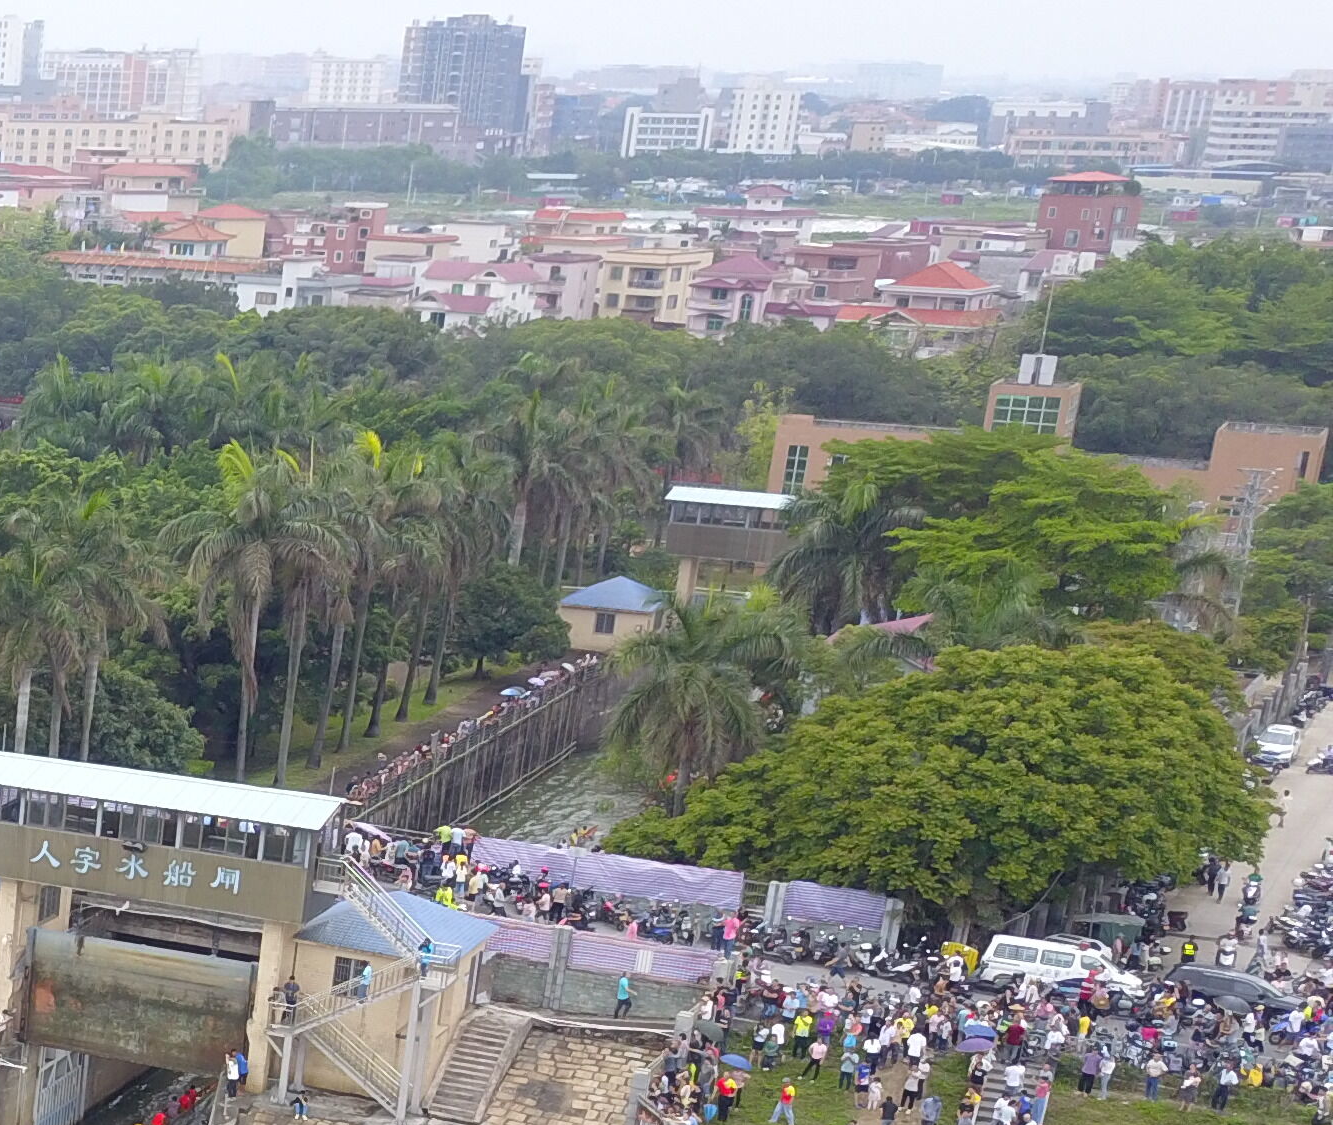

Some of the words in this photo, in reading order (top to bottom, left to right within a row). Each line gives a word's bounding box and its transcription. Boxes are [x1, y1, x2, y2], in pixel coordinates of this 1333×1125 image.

[29, 839, 242, 896] 人字水船闸
